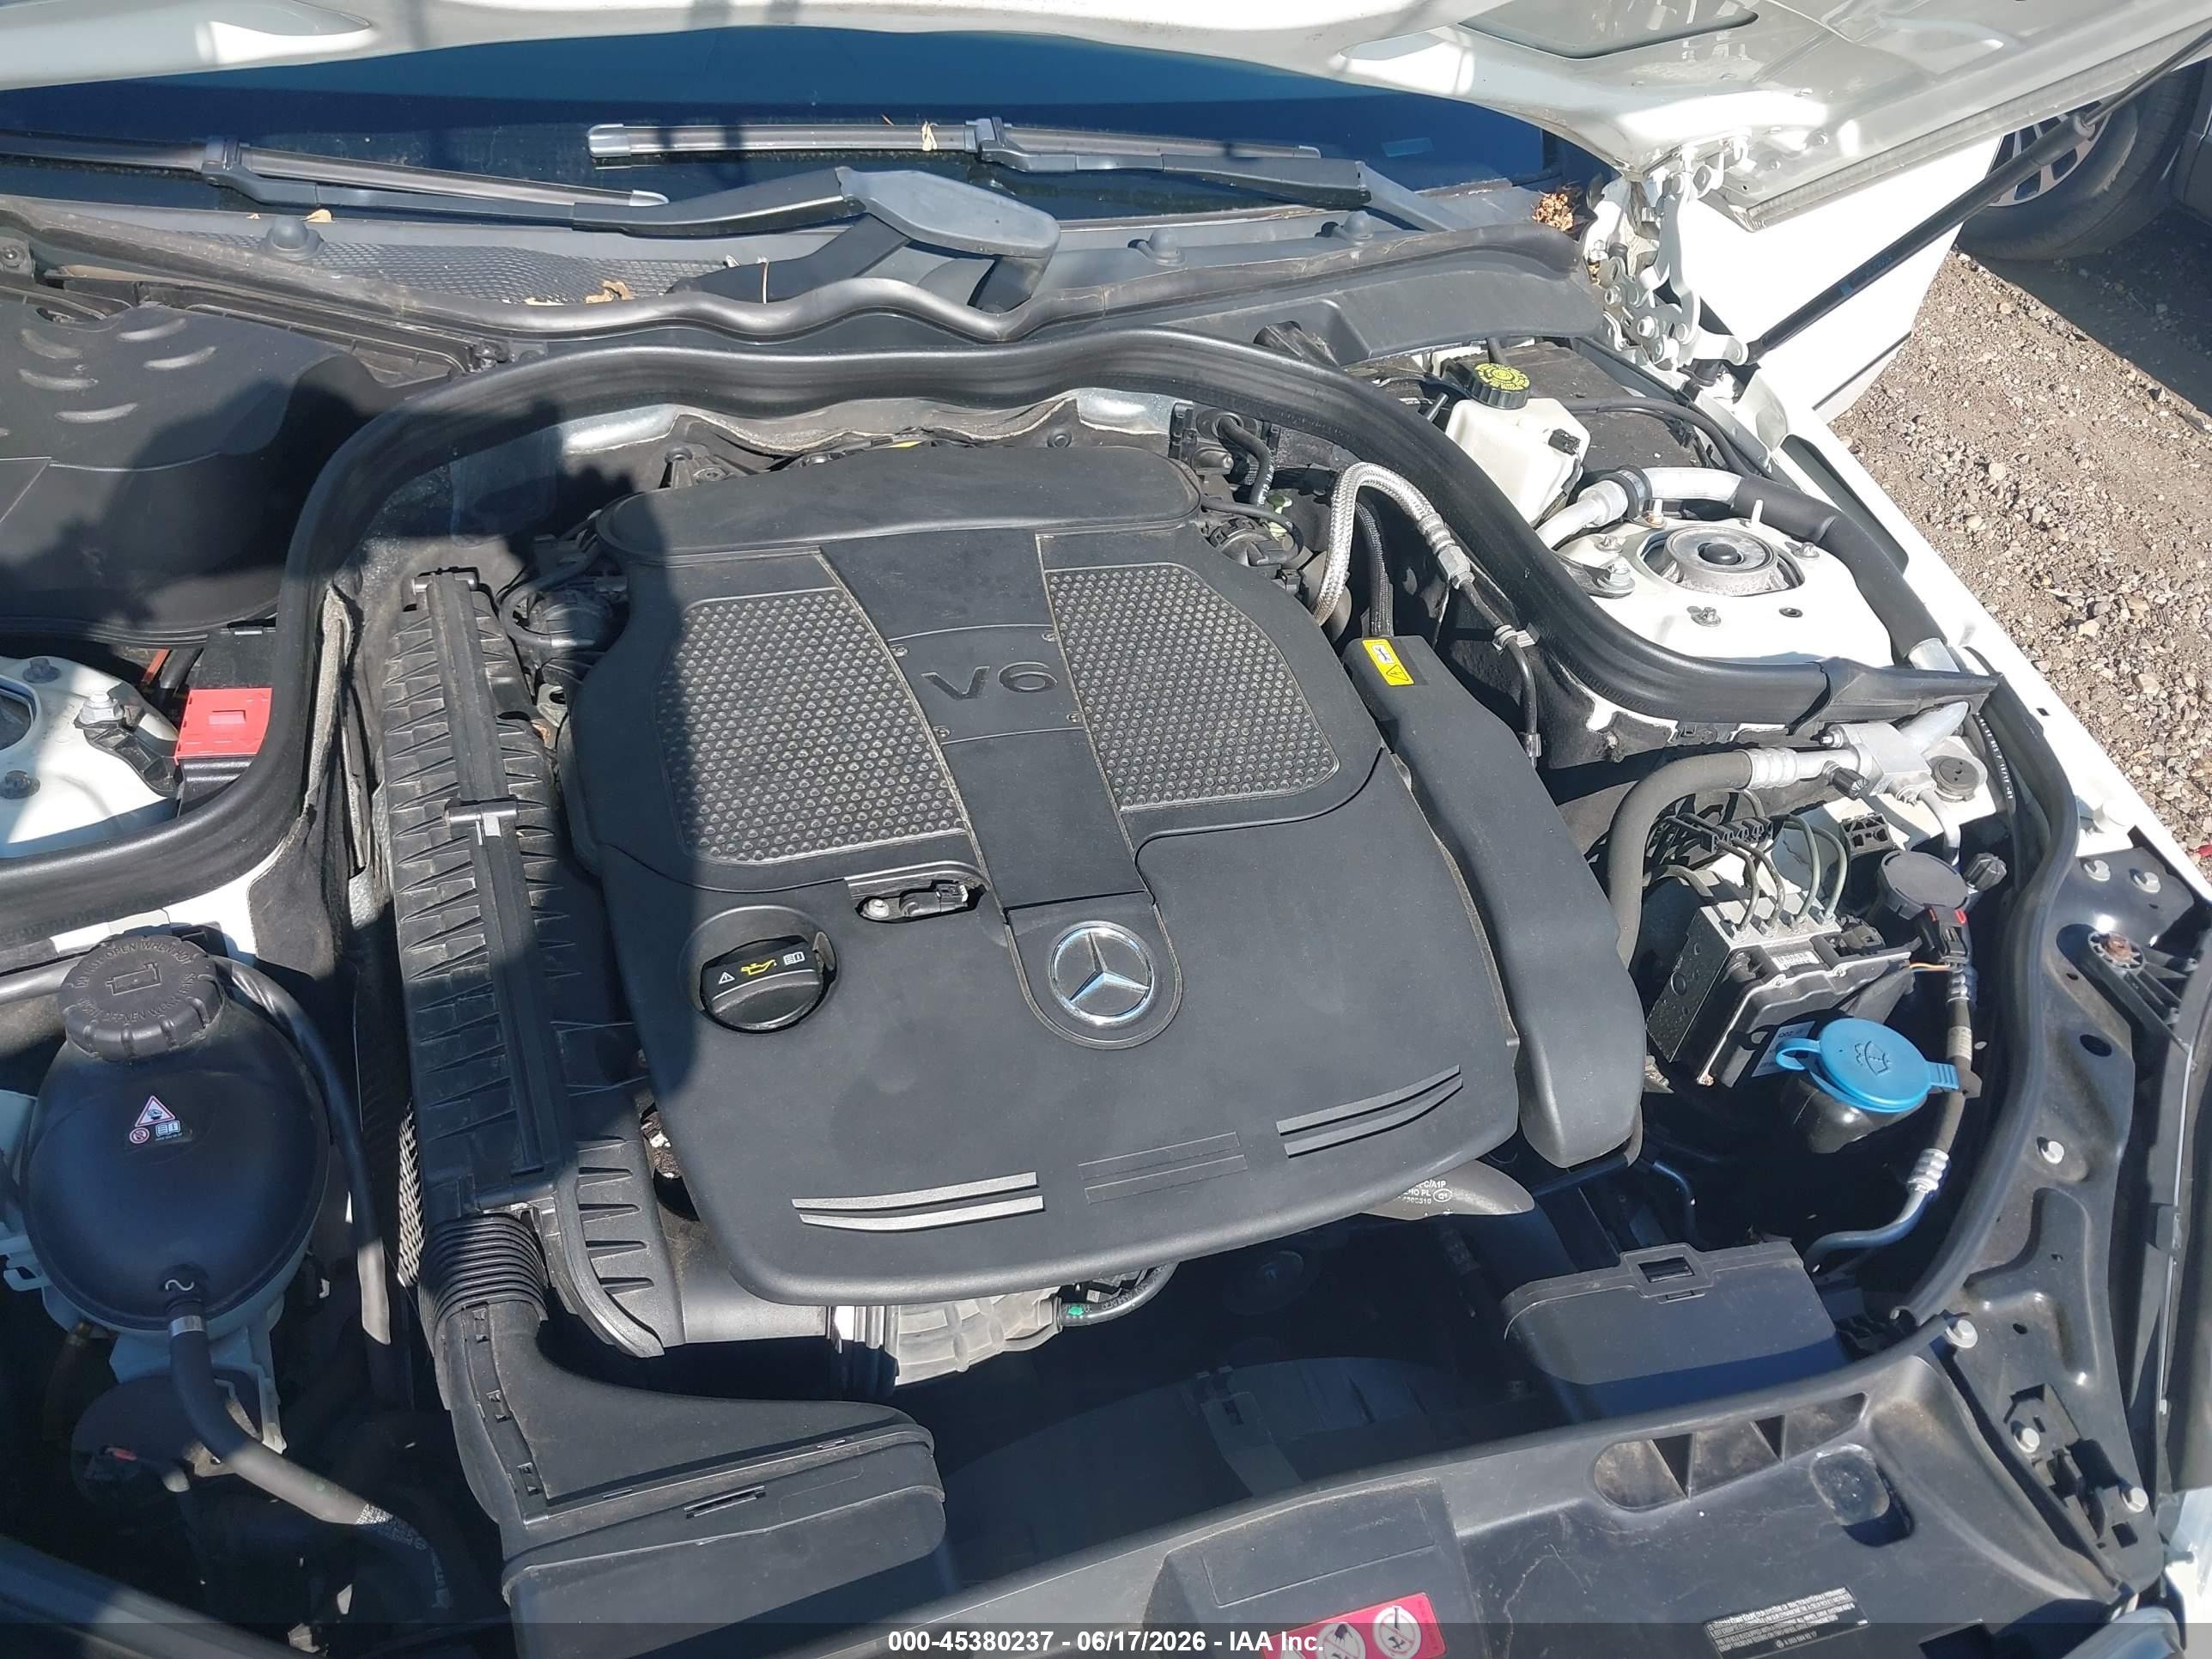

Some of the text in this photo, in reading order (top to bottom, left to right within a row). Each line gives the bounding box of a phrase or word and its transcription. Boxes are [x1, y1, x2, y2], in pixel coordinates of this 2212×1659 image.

[921, 660, 1059, 701] V6
[105, 943, 136, 958] OPEN
[140, 940, 174, 956] WHEN
